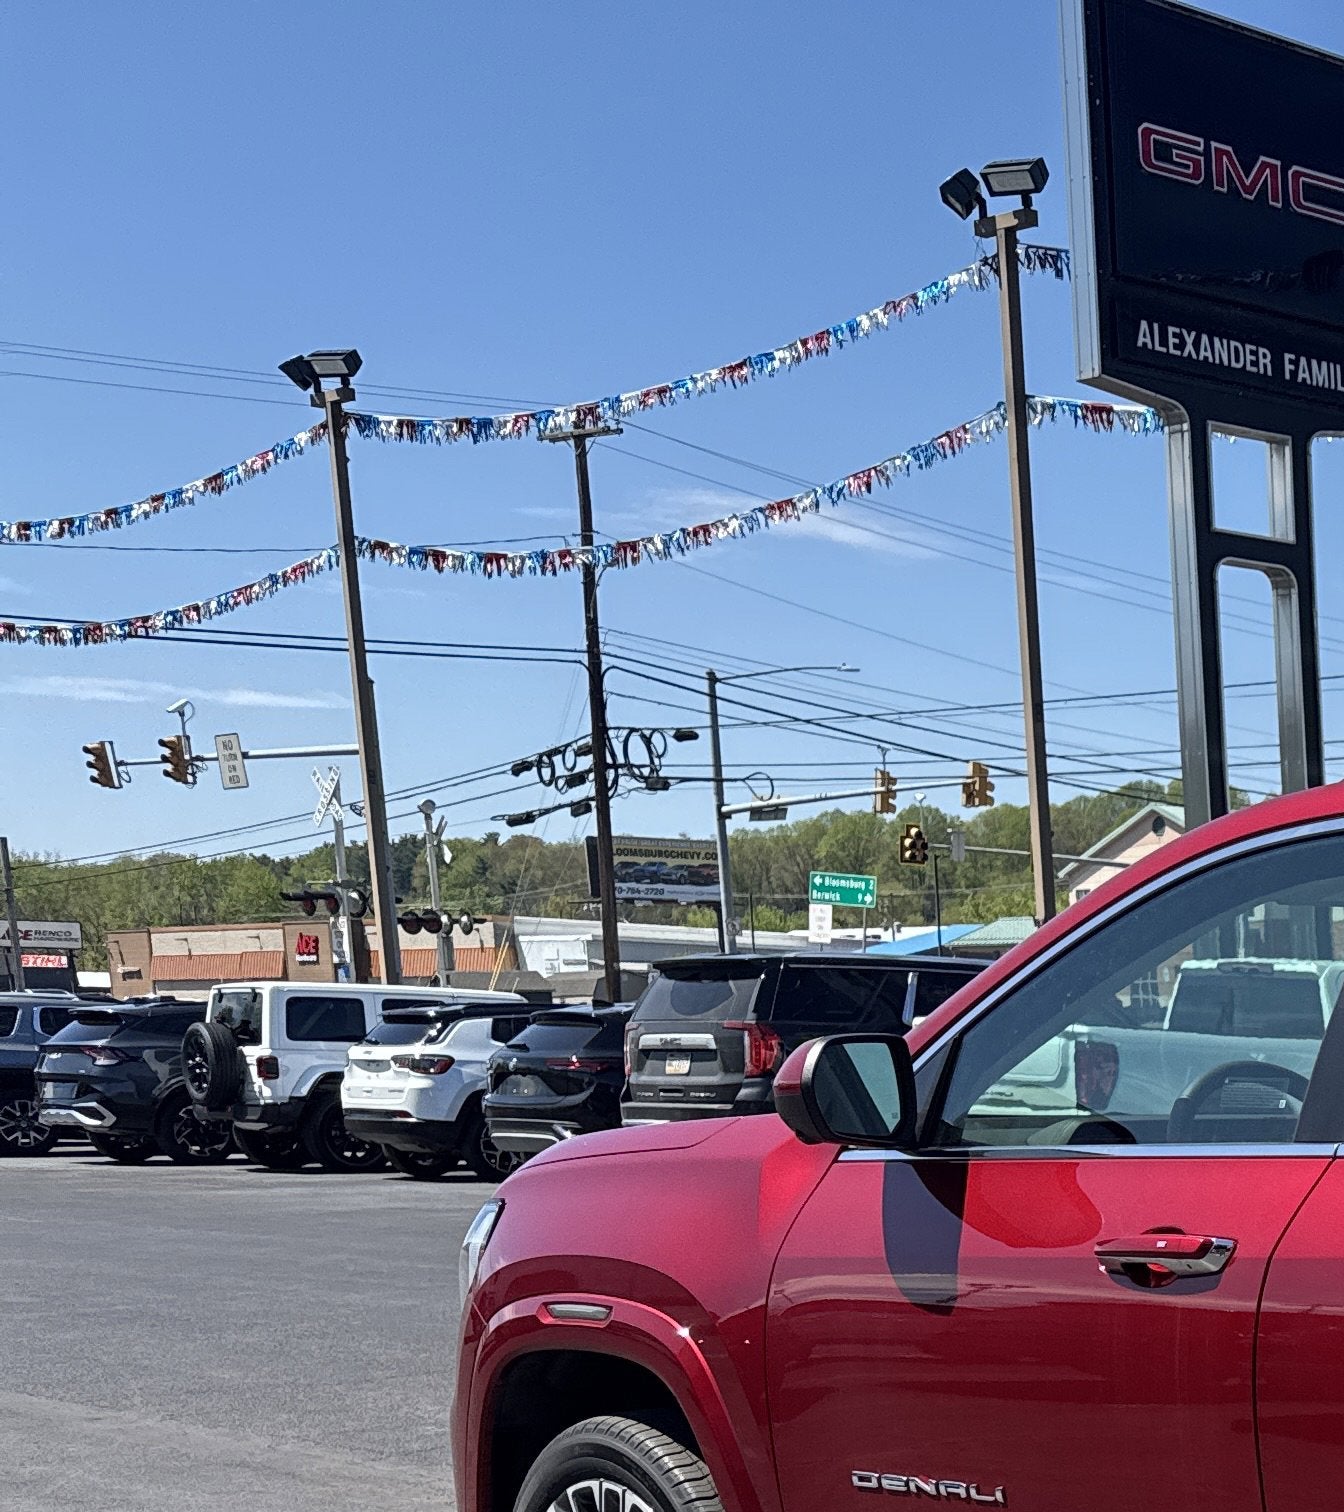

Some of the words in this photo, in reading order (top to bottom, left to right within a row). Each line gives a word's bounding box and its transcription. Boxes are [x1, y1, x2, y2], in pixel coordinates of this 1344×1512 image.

[1136, 319, 1273, 377] ALEXANDER
[222, 739, 233, 752] NO
[221, 753, 239, 763] TURN
[227, 764, 237, 773] ON
[228, 774, 241, 785] RED
[313, 766, 340, 824] CROSSING
[613, 848, 718, 861] OOMSBURGCHEVY.CO
[824, 876, 866, 891] Bloomsburg
[868, 879, 874, 891] 2
[812, 889, 841, 901] Berwick
[857, 892, 863, 903] 9
[34, 929, 73, 937] RENCO
[295, 932, 319, 955] ACE
[21, 954, 67, 967] STIHL
[851, 1470, 1005, 1504] DENALI
